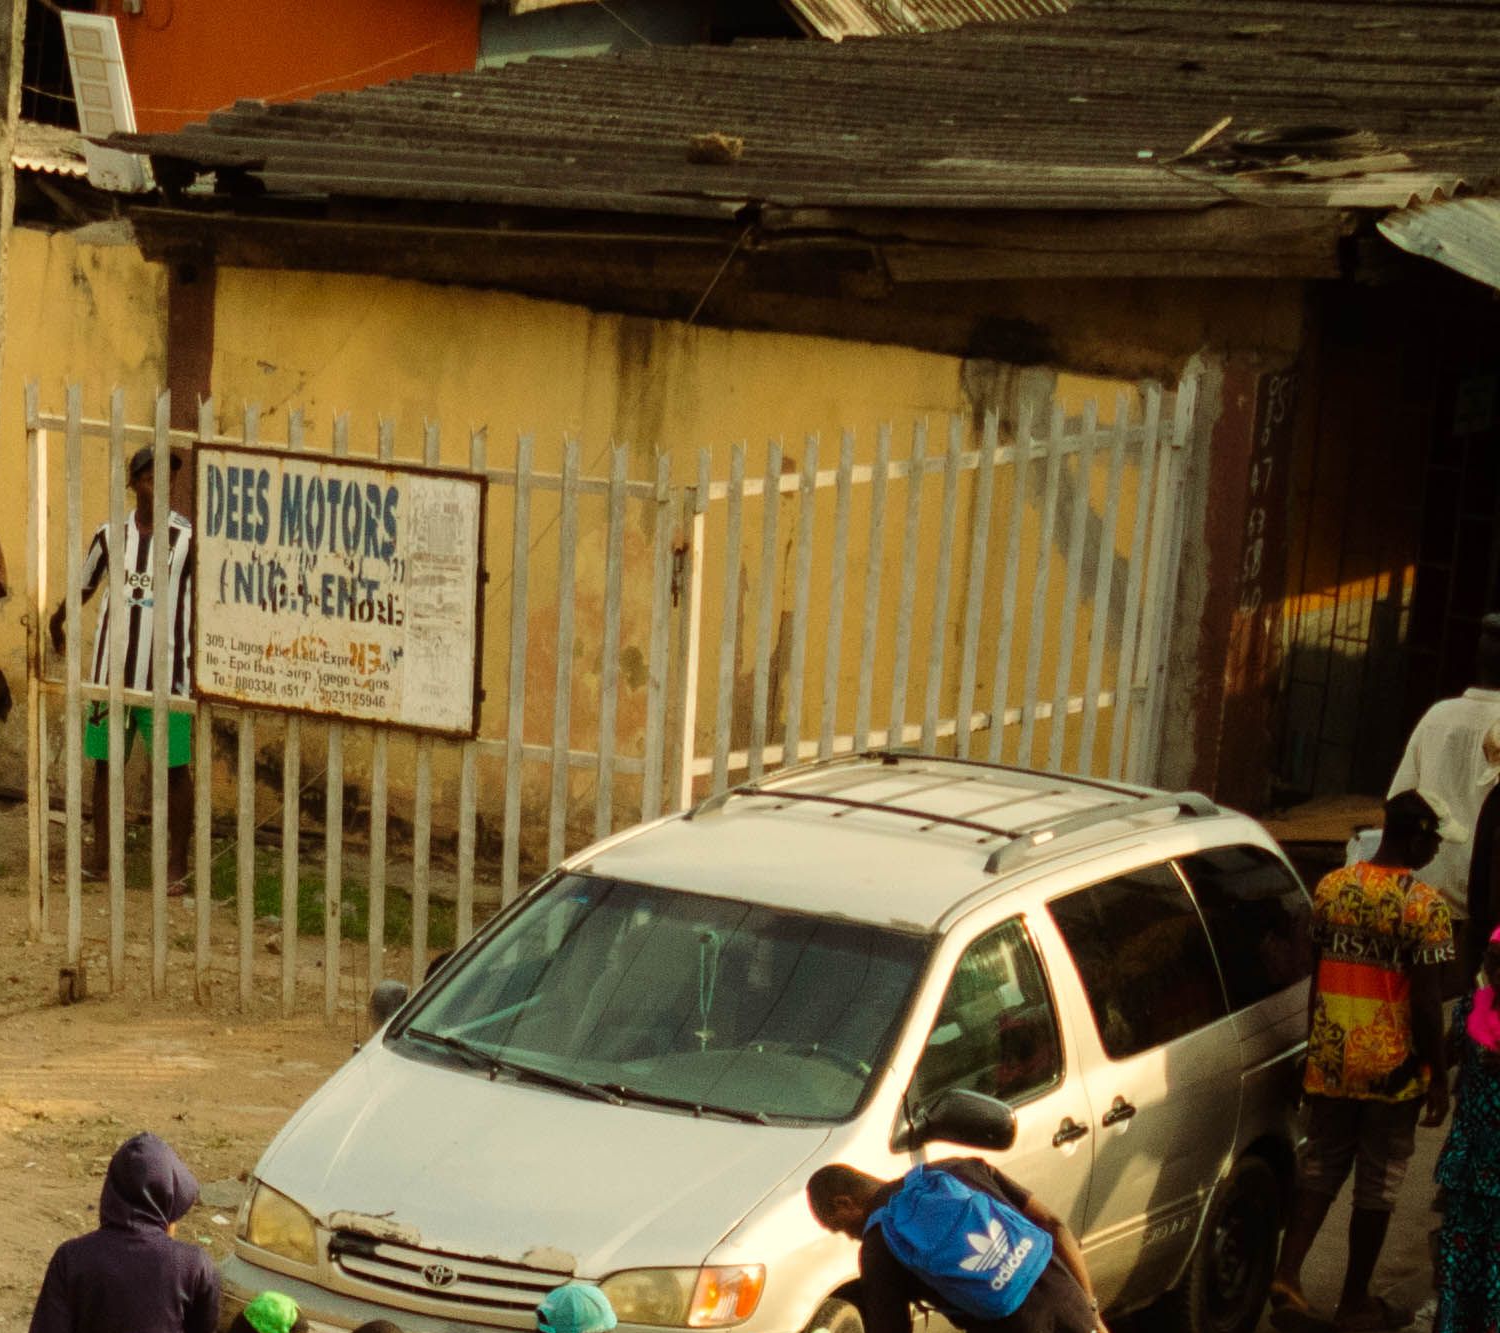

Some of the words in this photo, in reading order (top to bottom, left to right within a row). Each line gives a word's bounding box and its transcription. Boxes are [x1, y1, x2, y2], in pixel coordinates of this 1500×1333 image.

[206, 464, 270, 545] DEES
[278, 472, 399, 560] MOTORS
[991, 1238, 1033, 1291] adidas
